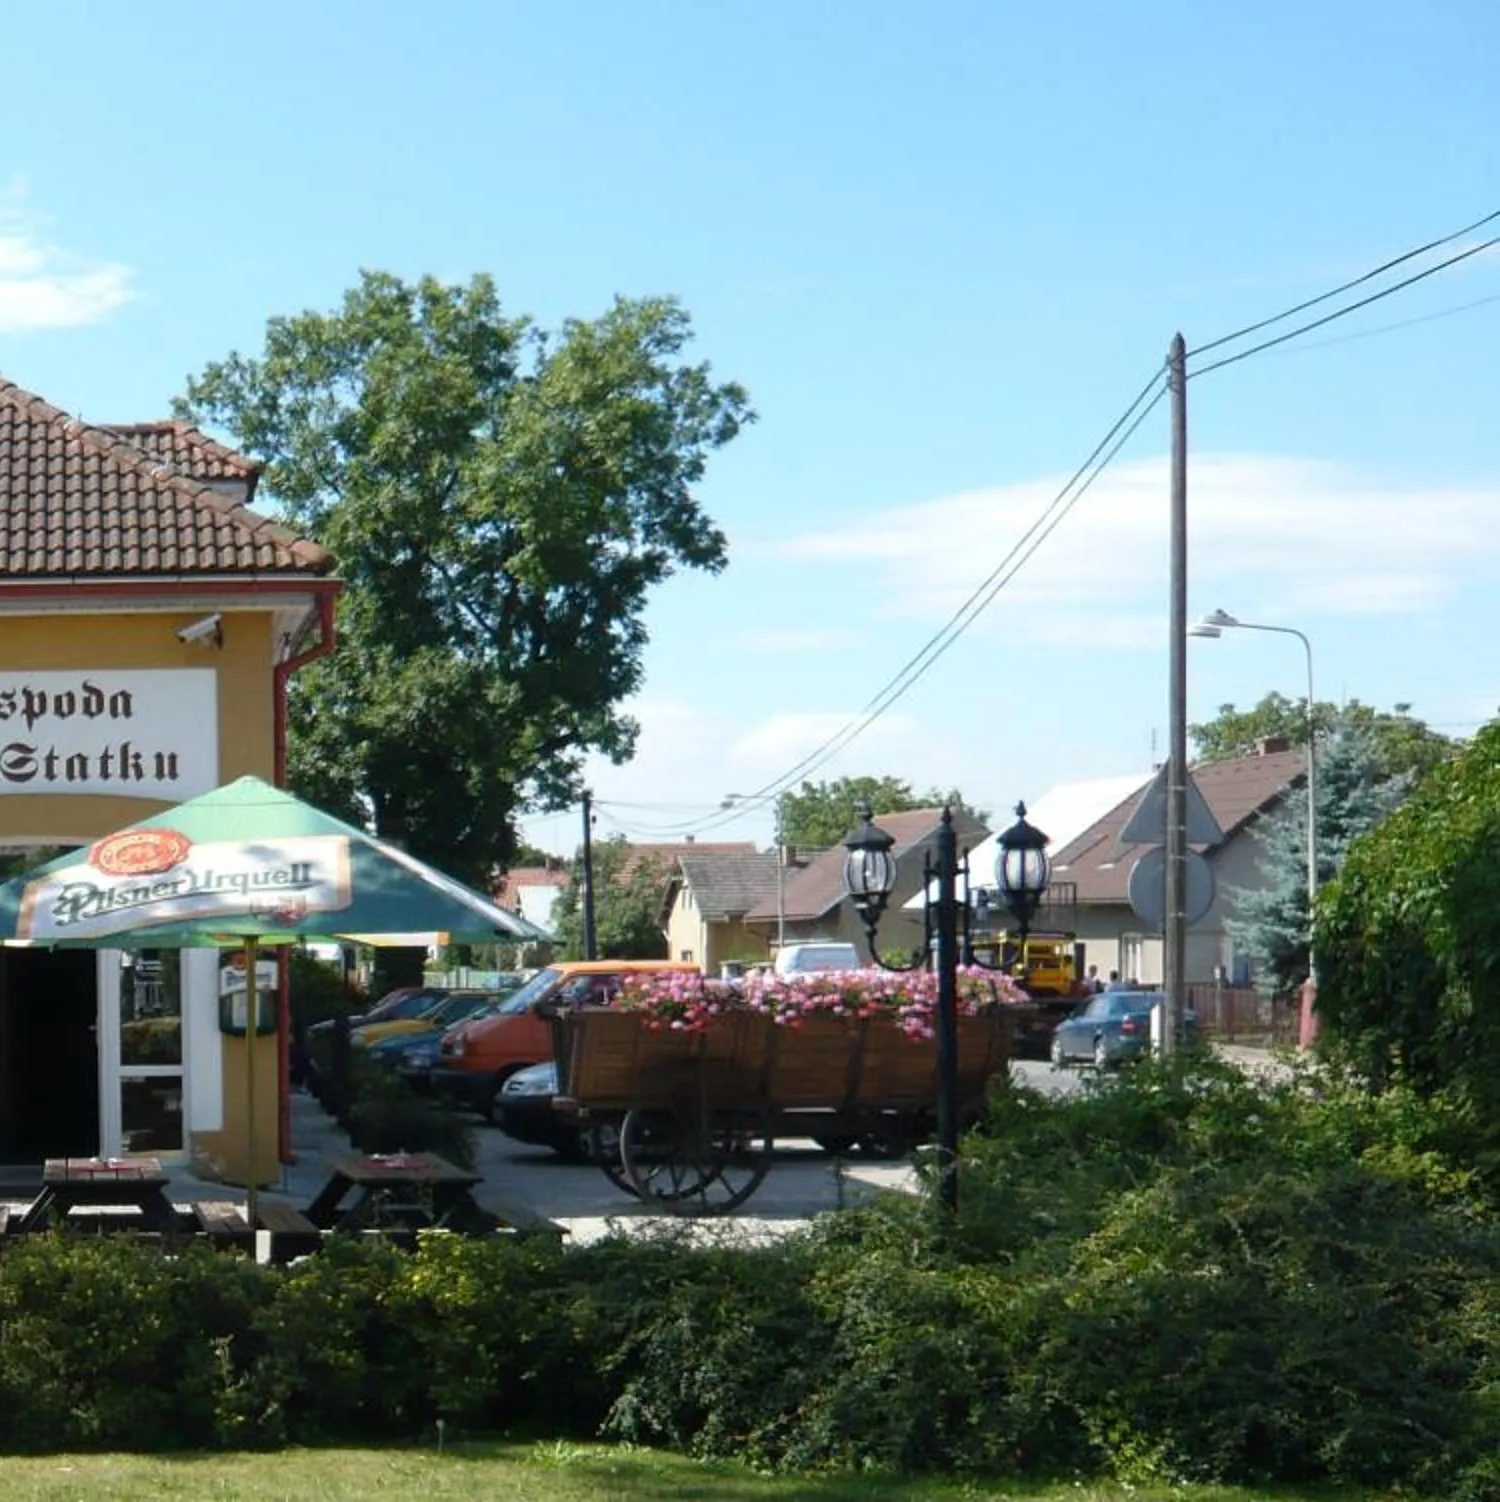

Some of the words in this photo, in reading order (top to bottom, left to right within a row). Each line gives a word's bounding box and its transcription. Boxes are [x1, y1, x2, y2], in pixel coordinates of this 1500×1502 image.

[0, 741, 180, 783] Statku
[52, 879, 187, 926] Pilsner
[185, 863, 313, 896] Urquell
